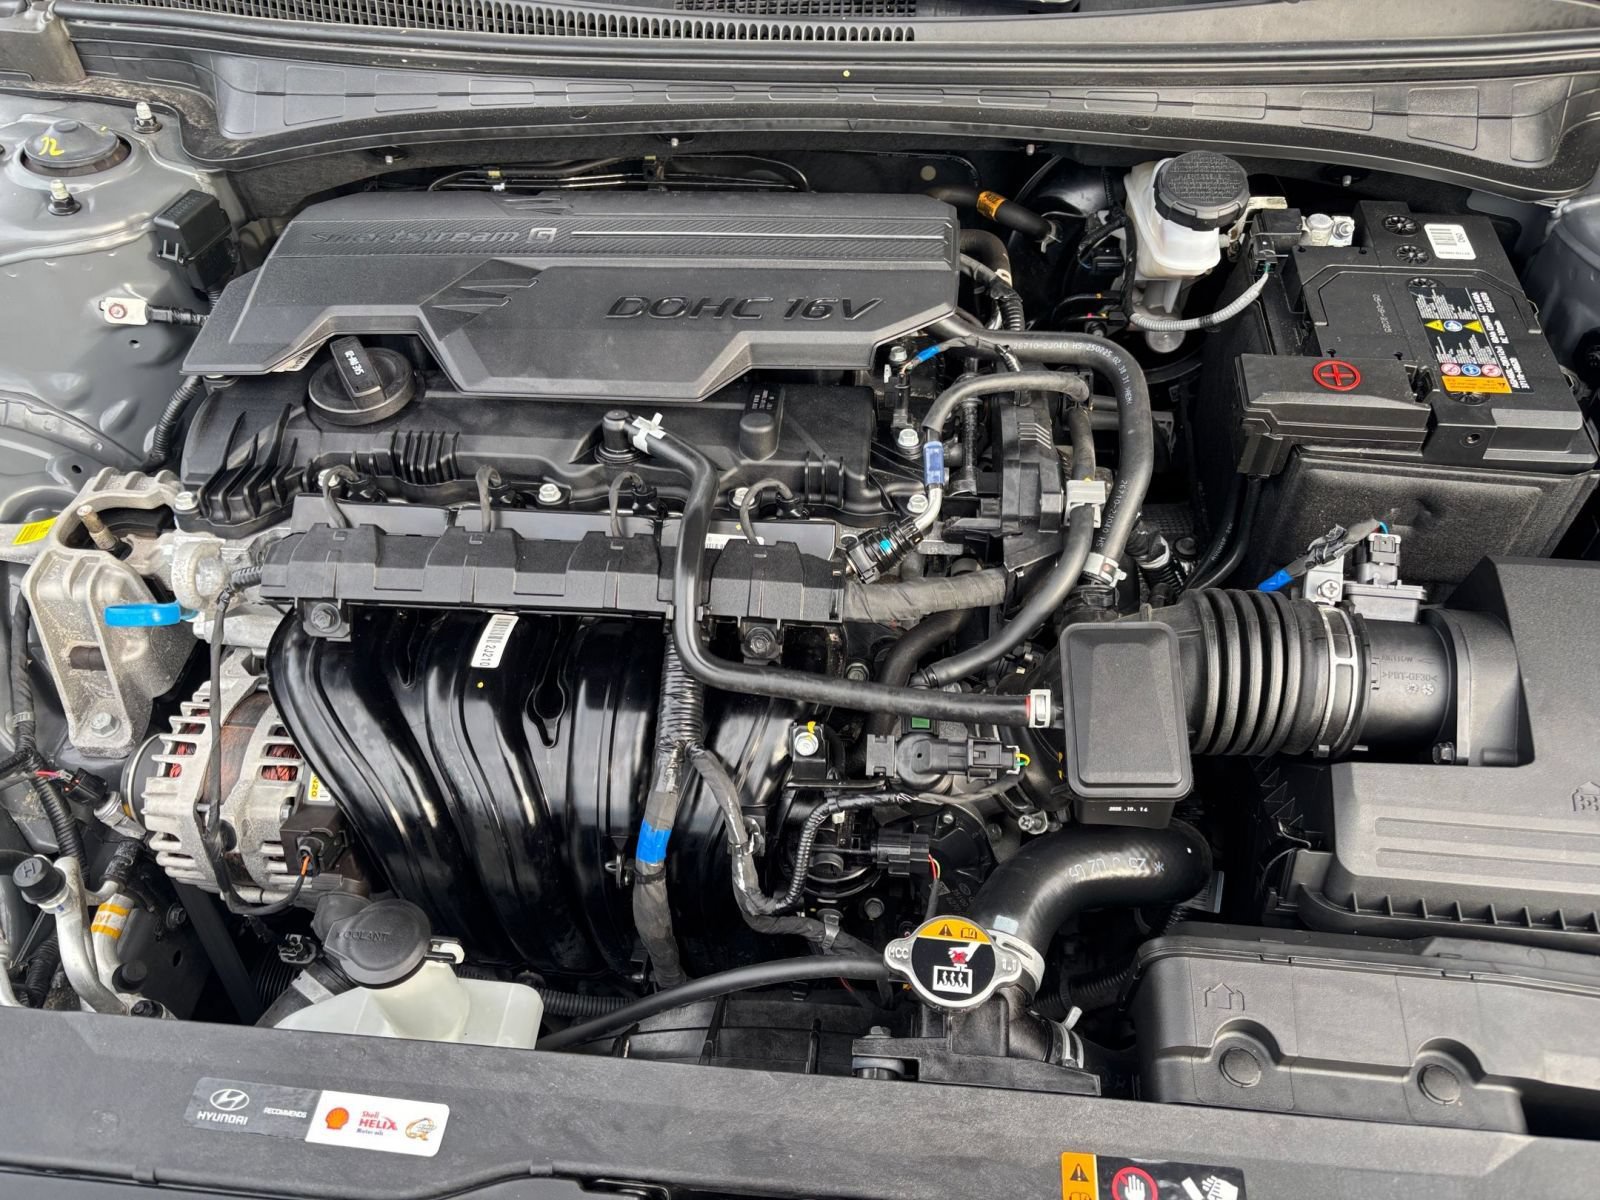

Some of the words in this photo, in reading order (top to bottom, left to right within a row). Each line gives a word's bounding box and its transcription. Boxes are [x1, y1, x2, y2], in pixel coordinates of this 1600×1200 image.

[604, 295, 774, 320] DOHC
[783, 297, 883, 321] 16V
[1013, 342, 1069, 350] 26710-2J040
[1072, 342, 1082, 350] HS
[1096, 536, 1107, 548] HS
[480, 644, 497, 667] 2J210
[196, 1110, 249, 1126] HYUNDAI
[263, 1107, 308, 1119] RECOMMENDS
[362, 1110, 380, 1119] Shell
[358, 1116, 398, 1131] HELIX
